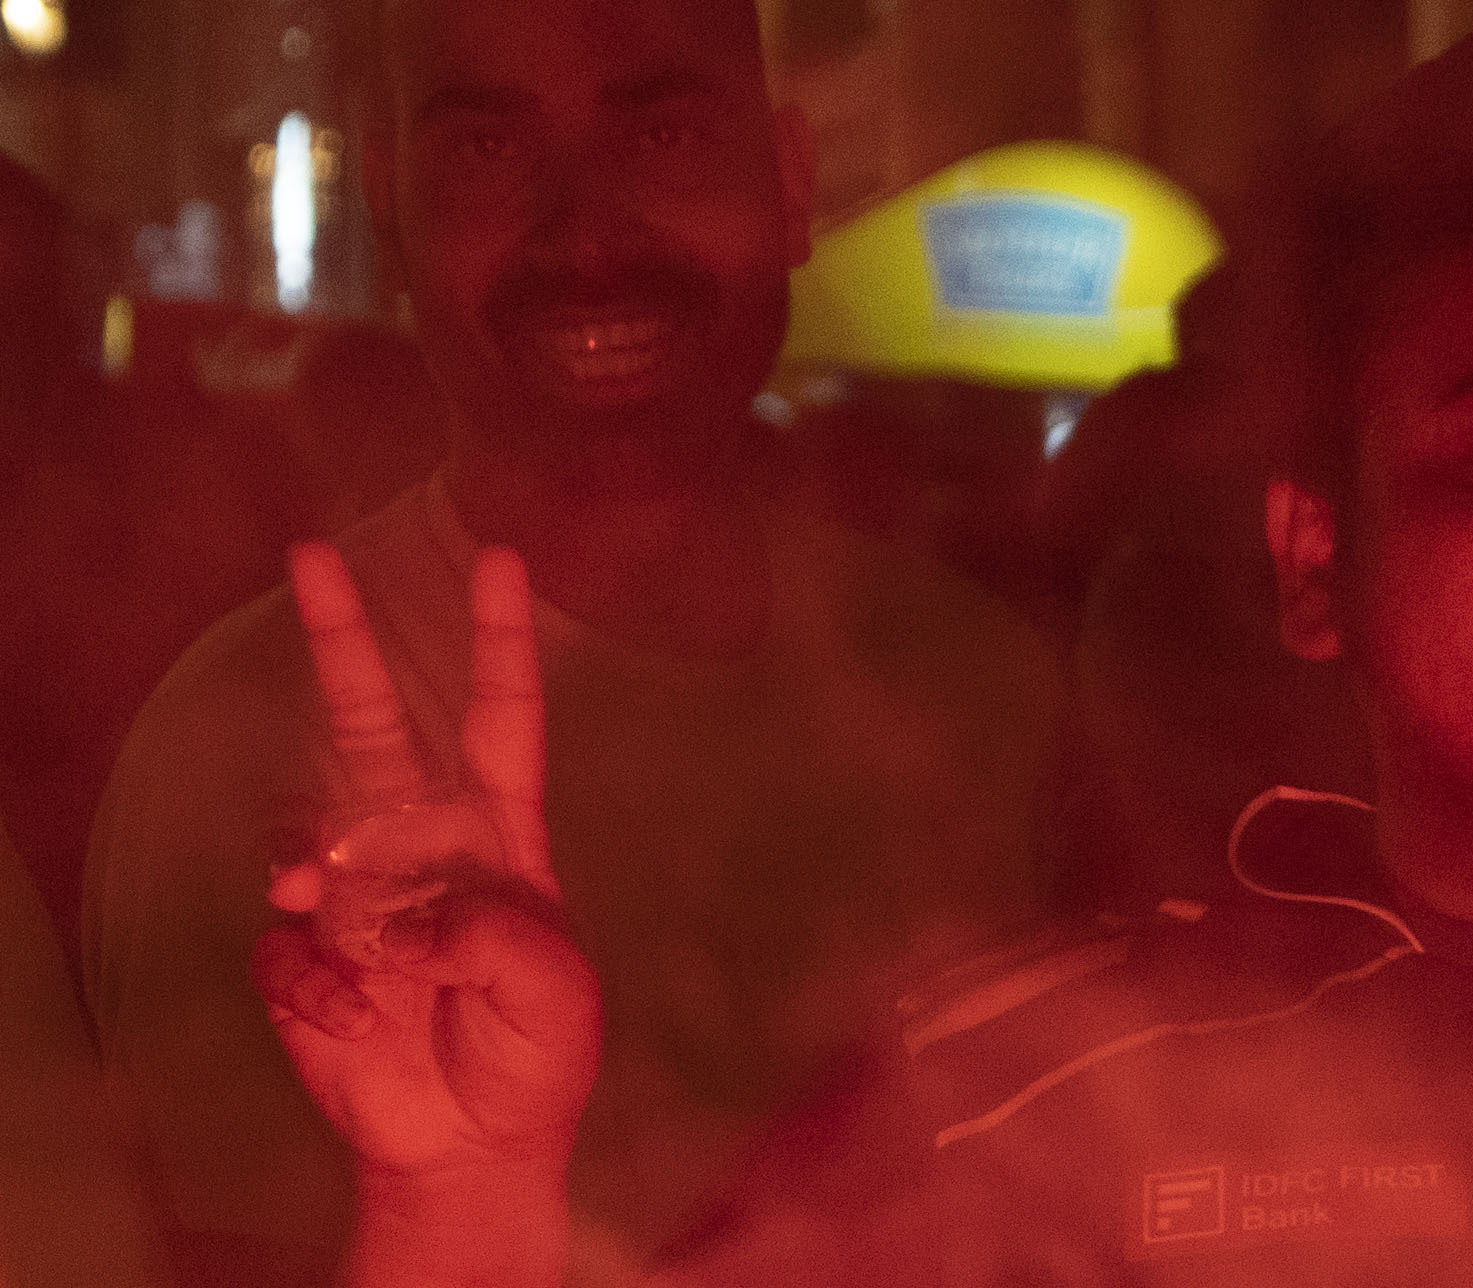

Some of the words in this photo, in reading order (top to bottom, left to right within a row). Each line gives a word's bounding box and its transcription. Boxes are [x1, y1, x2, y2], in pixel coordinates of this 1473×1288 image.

[1240, 1167, 1326, 1198] IDFC
[1340, 1162, 1446, 1191] FIRST
[1241, 1202, 1333, 1231] Bank
